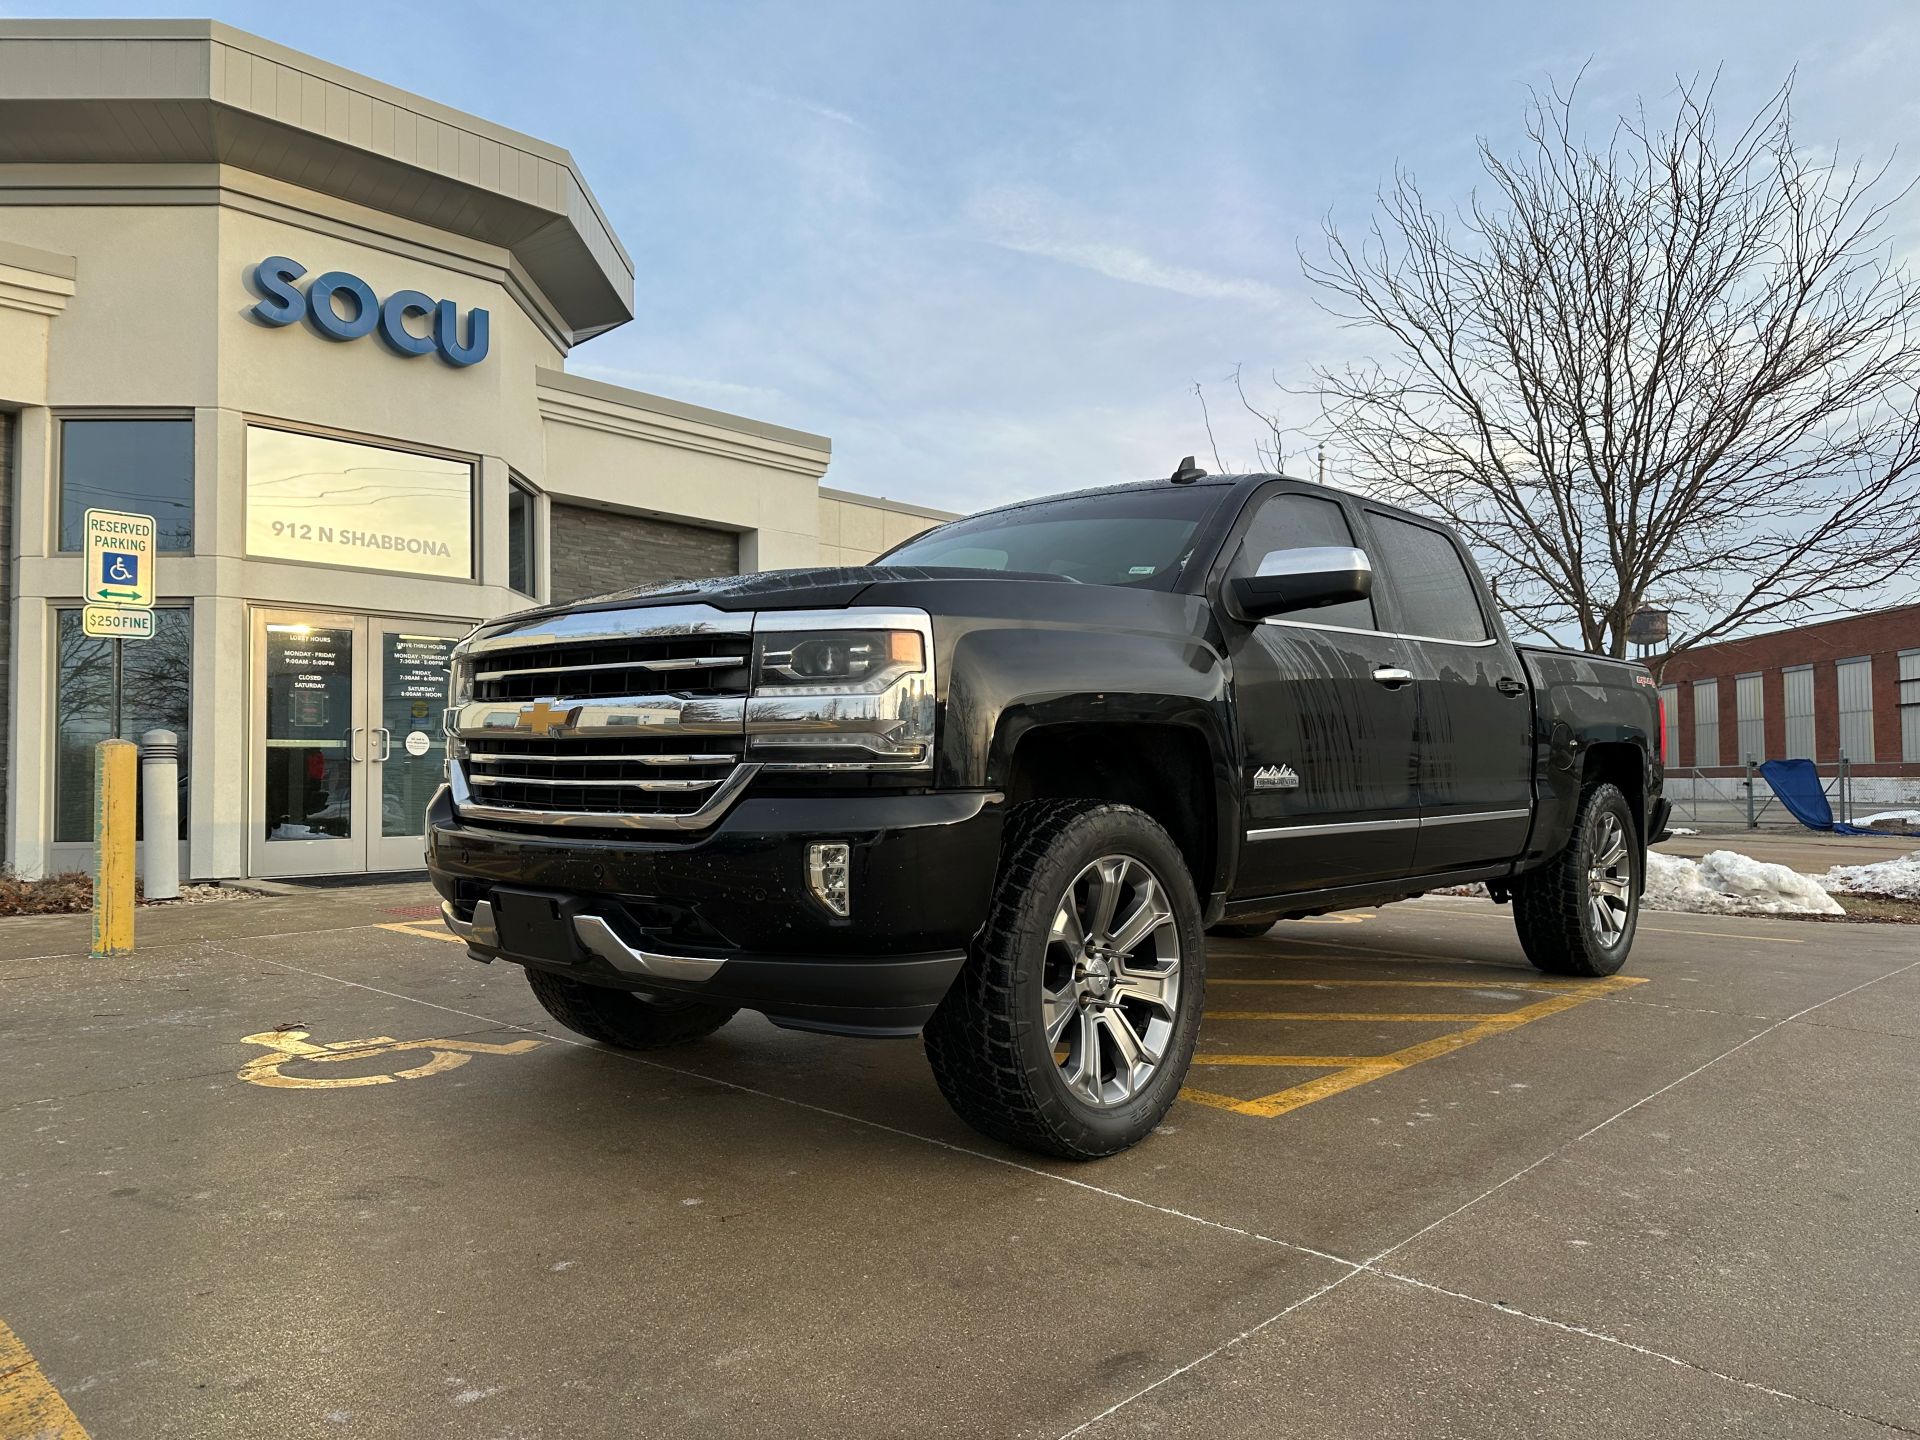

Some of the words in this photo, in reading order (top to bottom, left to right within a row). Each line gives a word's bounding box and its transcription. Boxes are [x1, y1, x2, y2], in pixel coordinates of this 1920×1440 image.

[250, 255, 490, 368] SOCU
[91, 519, 150, 537] RESERVED
[94, 535, 146, 552] PARKING
[271, 520, 312, 541] 912
[318, 526, 333, 543] N
[339, 529, 451, 558] SHABBONA
[89, 614, 120, 627] $250
[122, 616, 149, 629] FINE
